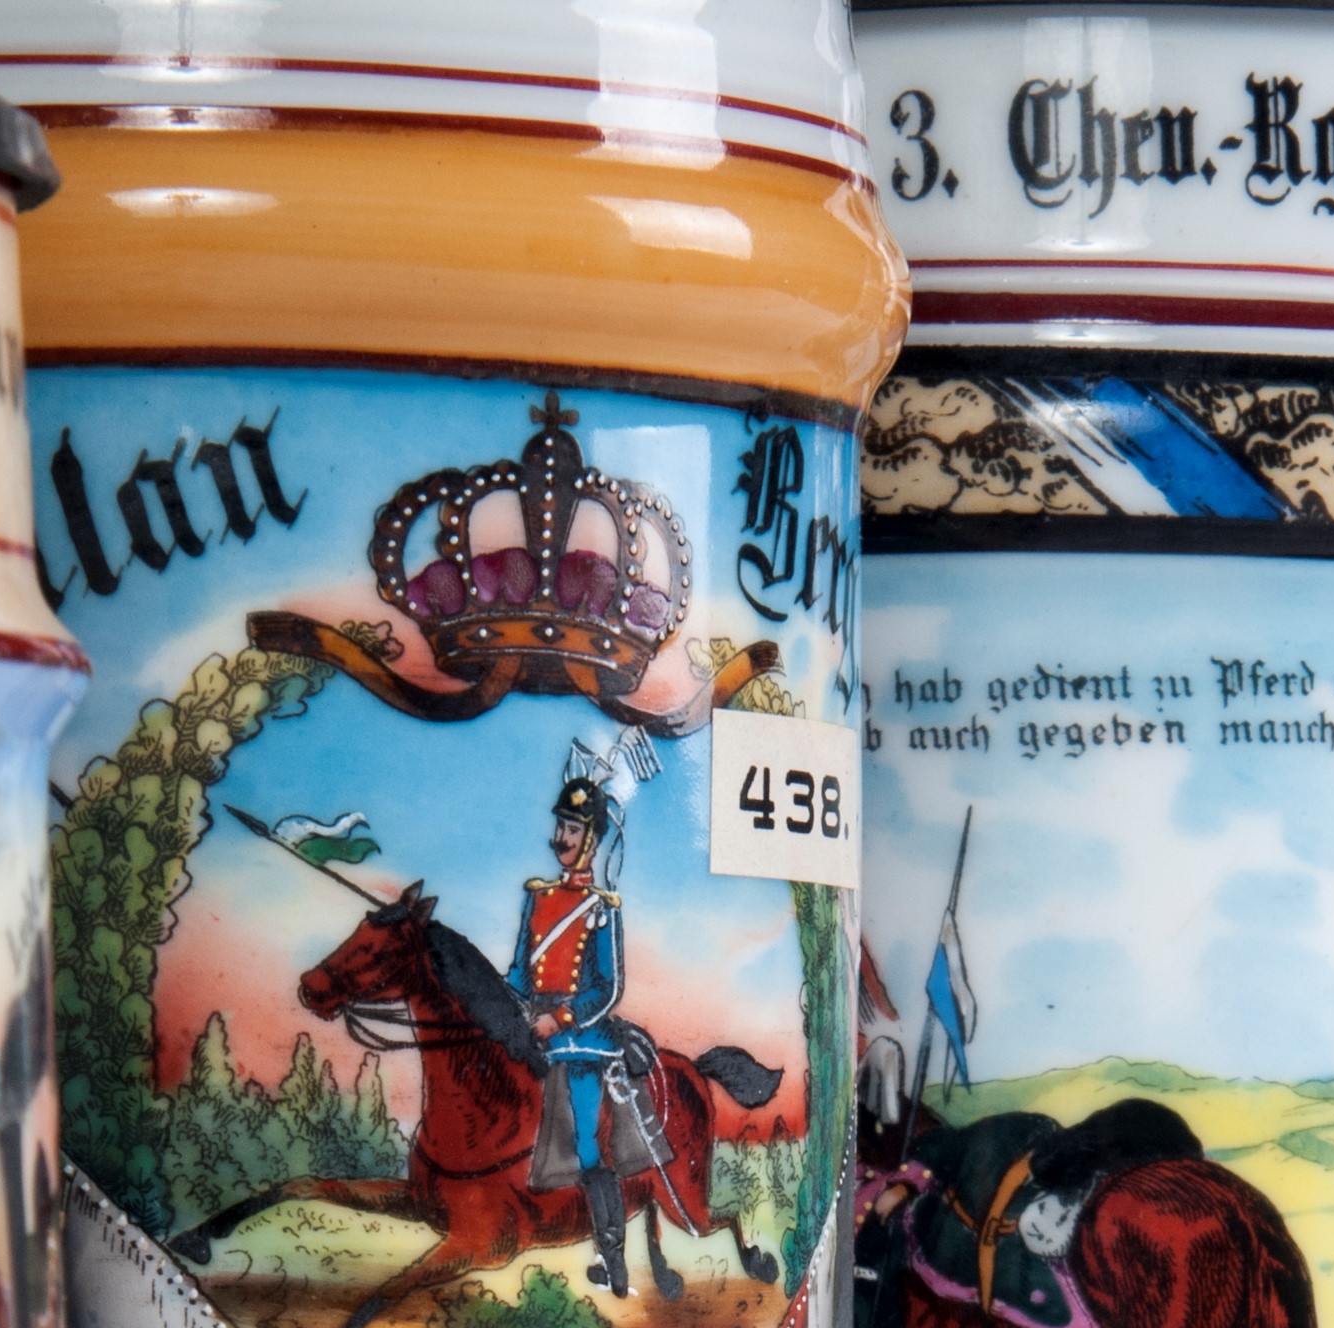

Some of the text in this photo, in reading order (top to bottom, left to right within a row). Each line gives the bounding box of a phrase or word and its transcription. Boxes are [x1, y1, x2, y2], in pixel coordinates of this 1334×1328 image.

[889, 88, 961, 202] 3.
[893, 666, 964, 712] hab
[987, 662, 1134, 714] gedient
[1152, 673, 1195, 713] zu
[1210, 655, 1316, 708] Pferd
[908, 713, 991, 753] auch
[1017, 712, 1187, 760] gegeben
